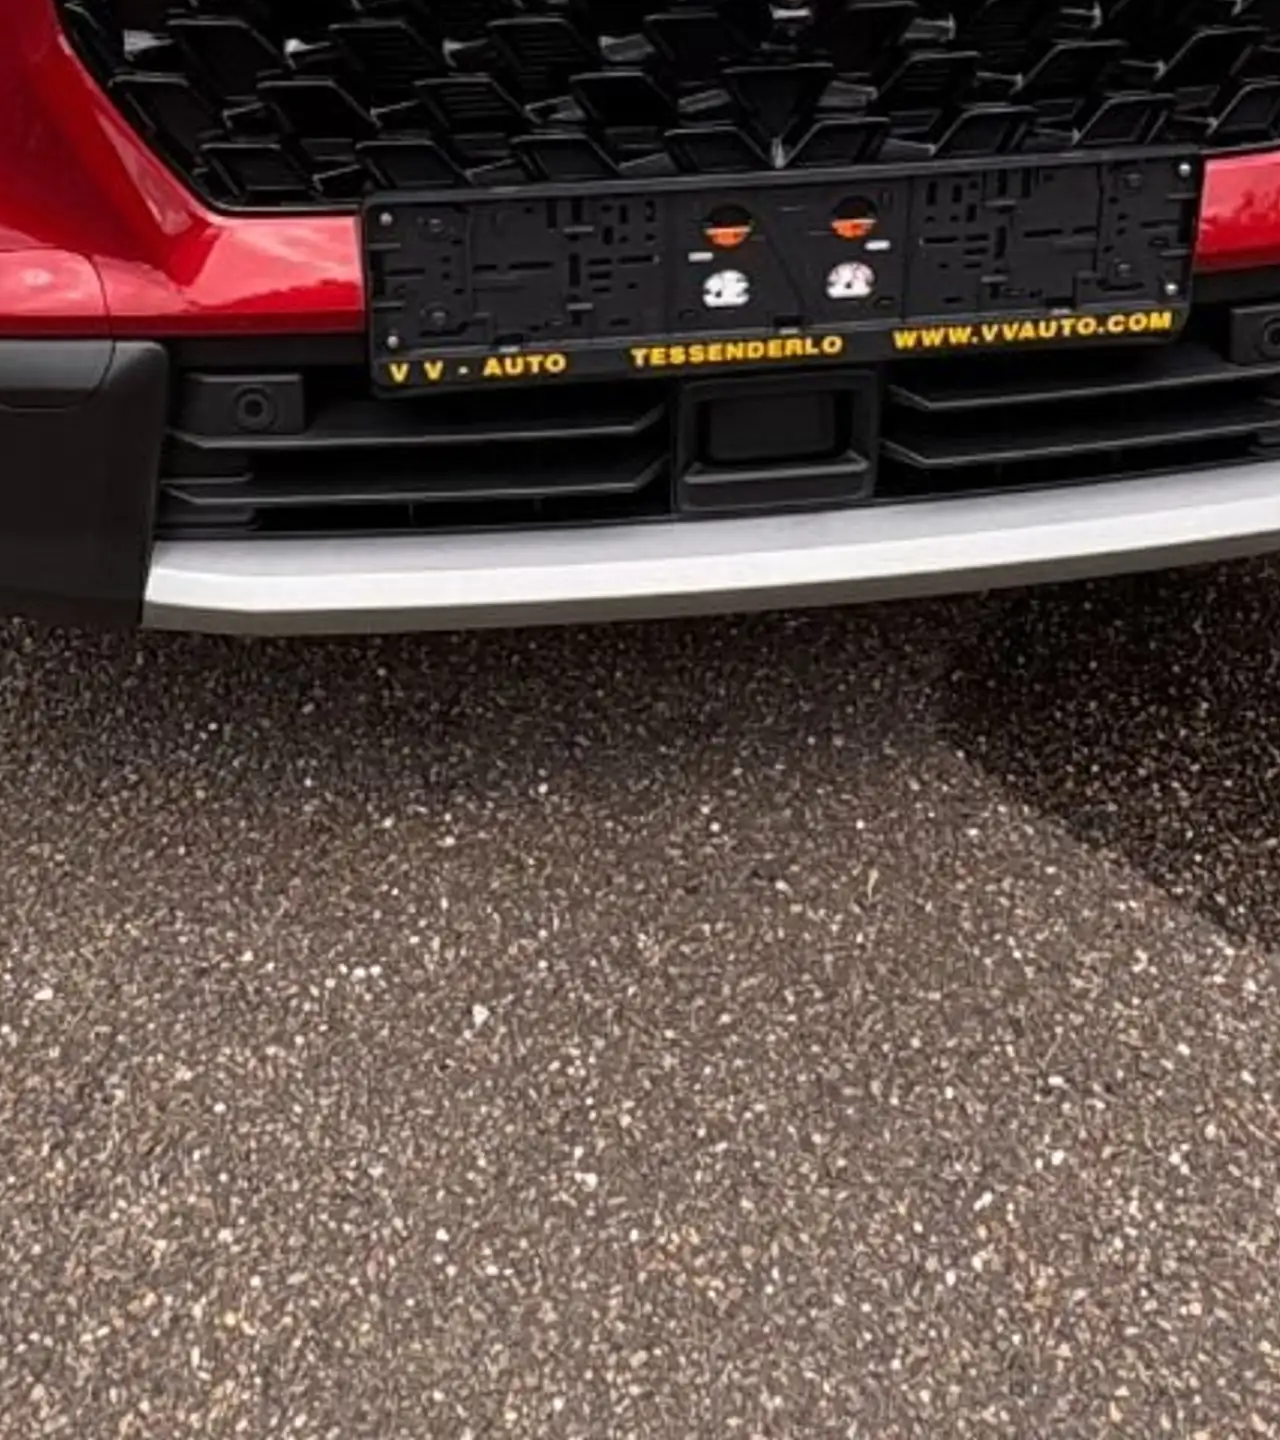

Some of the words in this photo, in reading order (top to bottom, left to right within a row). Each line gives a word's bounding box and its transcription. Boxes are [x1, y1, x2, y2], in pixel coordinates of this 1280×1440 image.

[389, 362, 409, 383] V
[424, 361, 444, 380] V
[483, 353, 567, 377] AUTO
[631, 335, 843, 367] TESSENDERLO
[893, 311, 1173, 350] WWW.VVAUTO.COM
